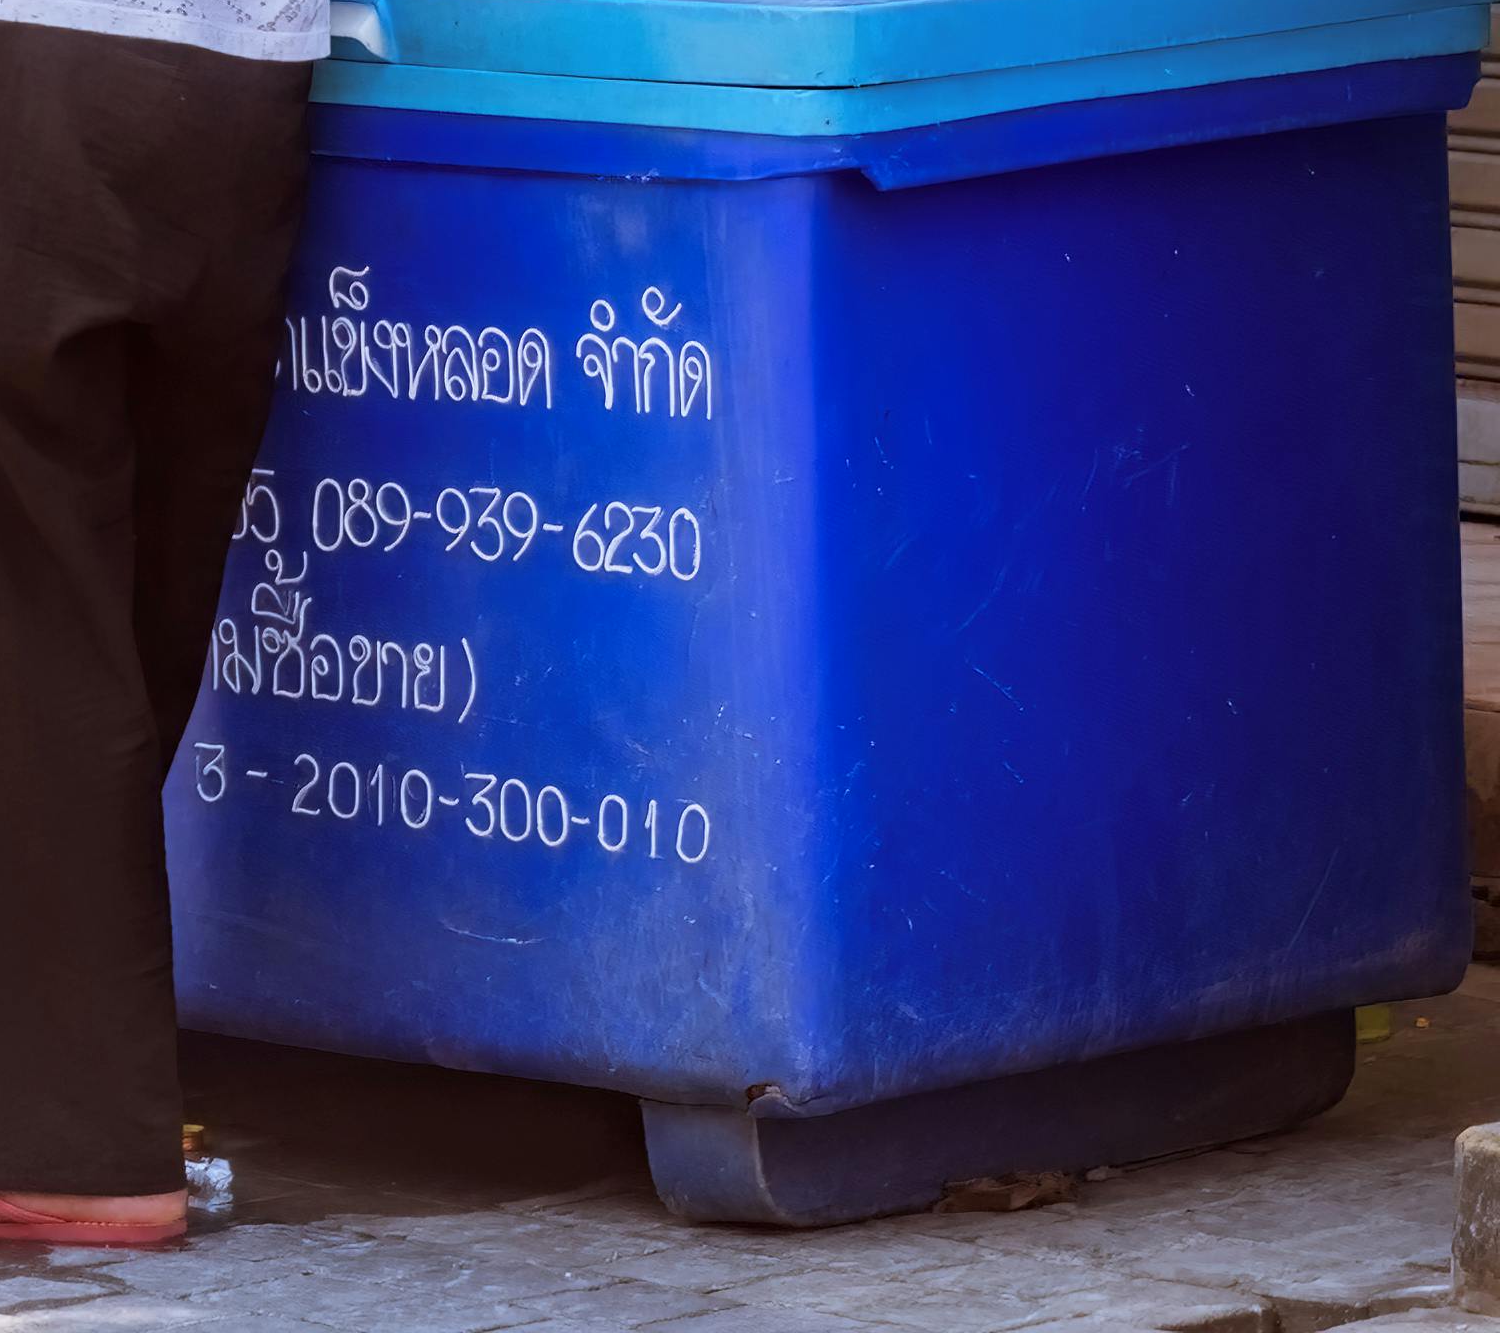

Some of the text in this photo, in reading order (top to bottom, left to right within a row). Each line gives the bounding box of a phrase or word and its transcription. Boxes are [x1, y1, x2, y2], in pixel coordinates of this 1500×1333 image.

[575, 286, 713, 421] จำกัด
[311, 477, 701, 581] 089-939-6230
[291, 753, 711, 864] 2010-300-010
